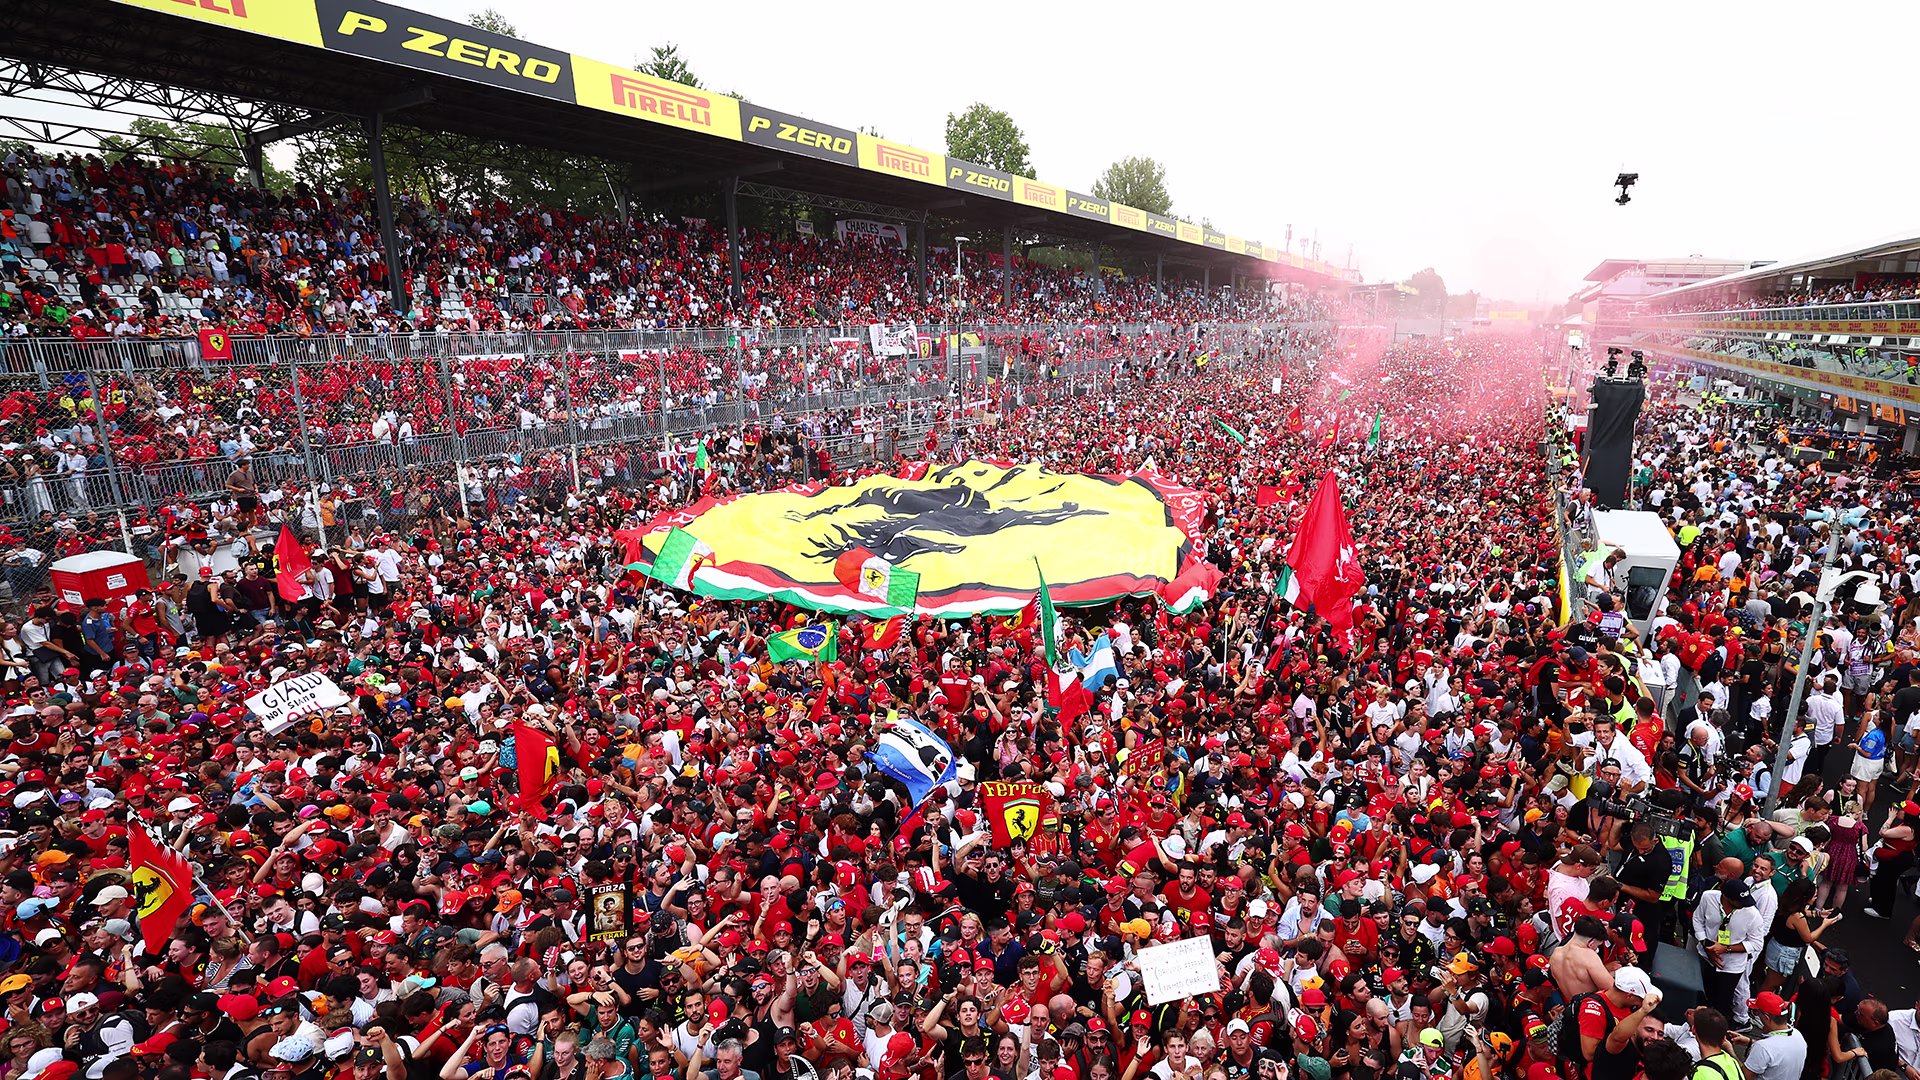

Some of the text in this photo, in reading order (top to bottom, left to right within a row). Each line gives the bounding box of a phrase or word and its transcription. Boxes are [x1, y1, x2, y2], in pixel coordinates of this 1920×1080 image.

[337, 10, 561, 84] P ZERO
[610, 73, 711, 127] PIRELLI
[748, 115, 852, 155] P ZERO
[876, 143, 930, 177] PIRELLI
[949, 166, 1011, 193] P ZERO
[1023, 182, 1057, 207] PIRELLI
[1068, 197, 1108, 216] P ZERO
[845, 220, 879, 234] CHARLES
[1117, 207, 1140, 226] PIRELLI
[1147, 218, 1176, 234] P ZERO
[262, 673, 322, 708] GIALLU
[266, 693, 315, 720] NOI SIAMO
[1672, 864, 1682, 873] 39
[592, 883, 626, 895] FORZA
